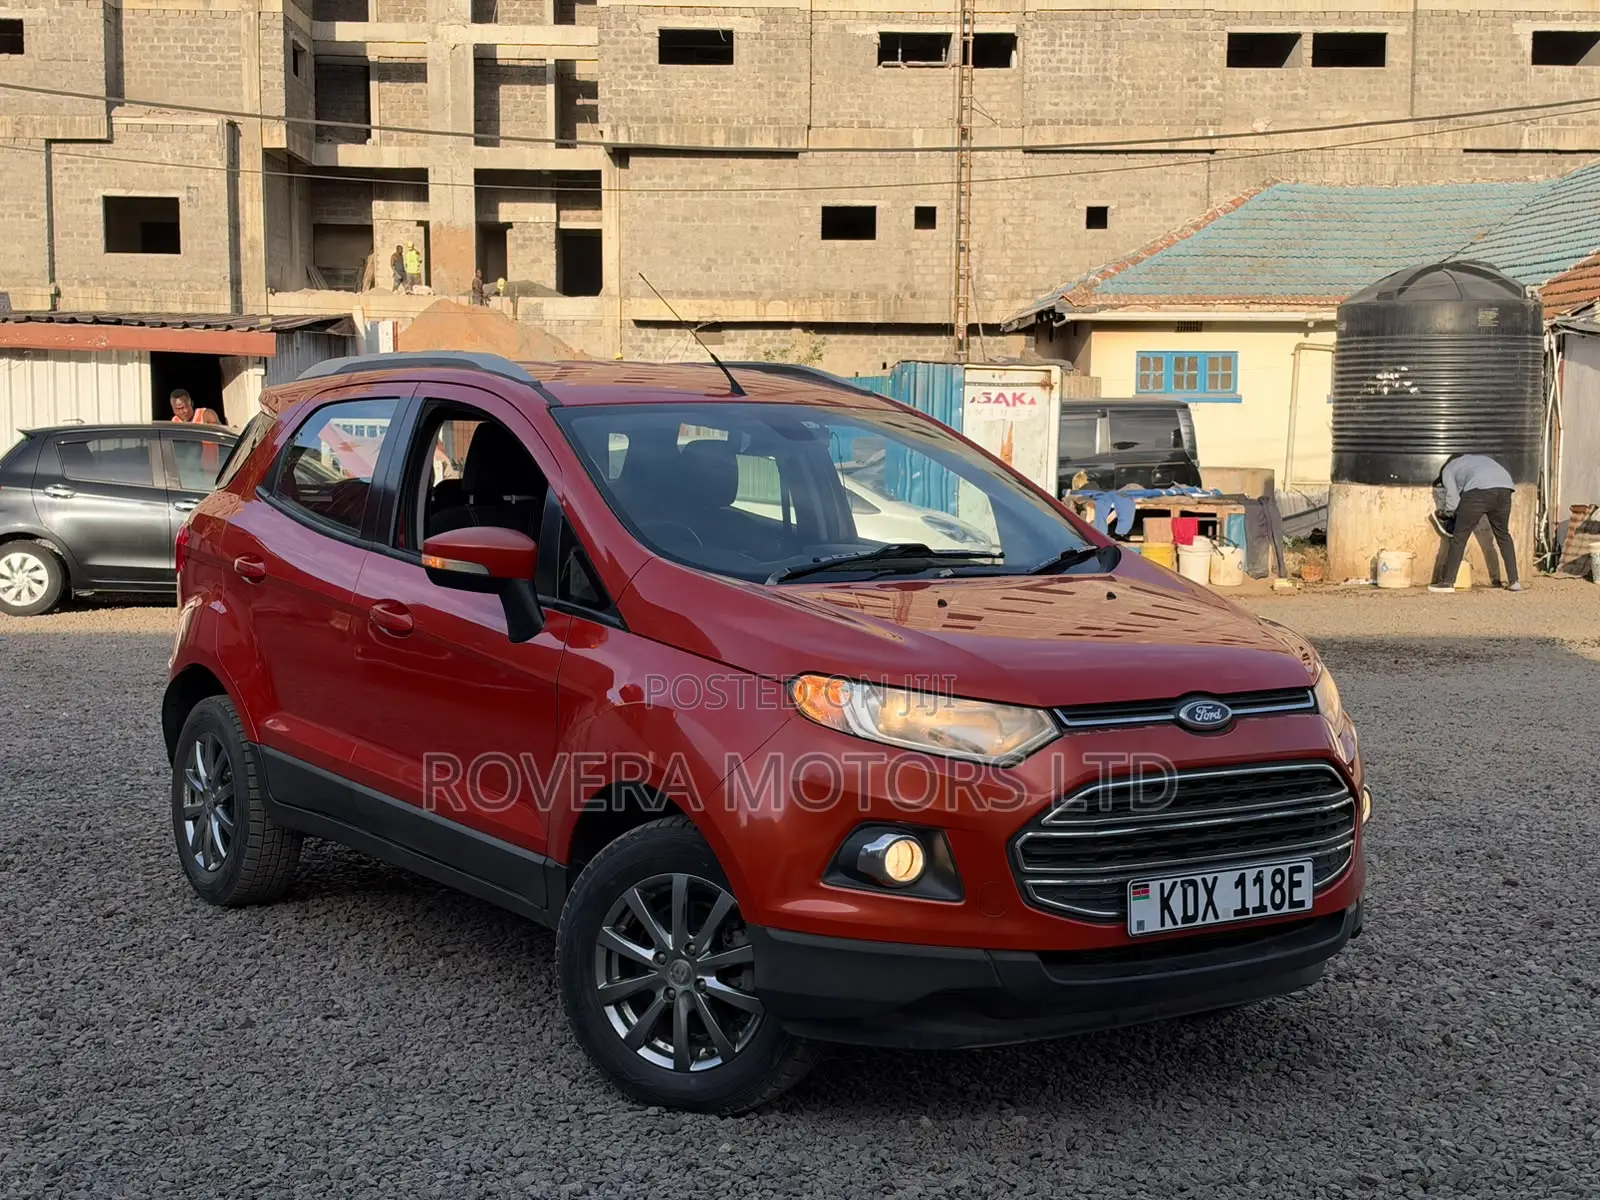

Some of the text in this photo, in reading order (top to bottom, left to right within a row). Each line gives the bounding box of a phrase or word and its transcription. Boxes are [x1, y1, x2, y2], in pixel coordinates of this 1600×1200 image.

[1194, 705, 1223, 721] Ford
[1159, 865, 1306, 928] KDX 118E
